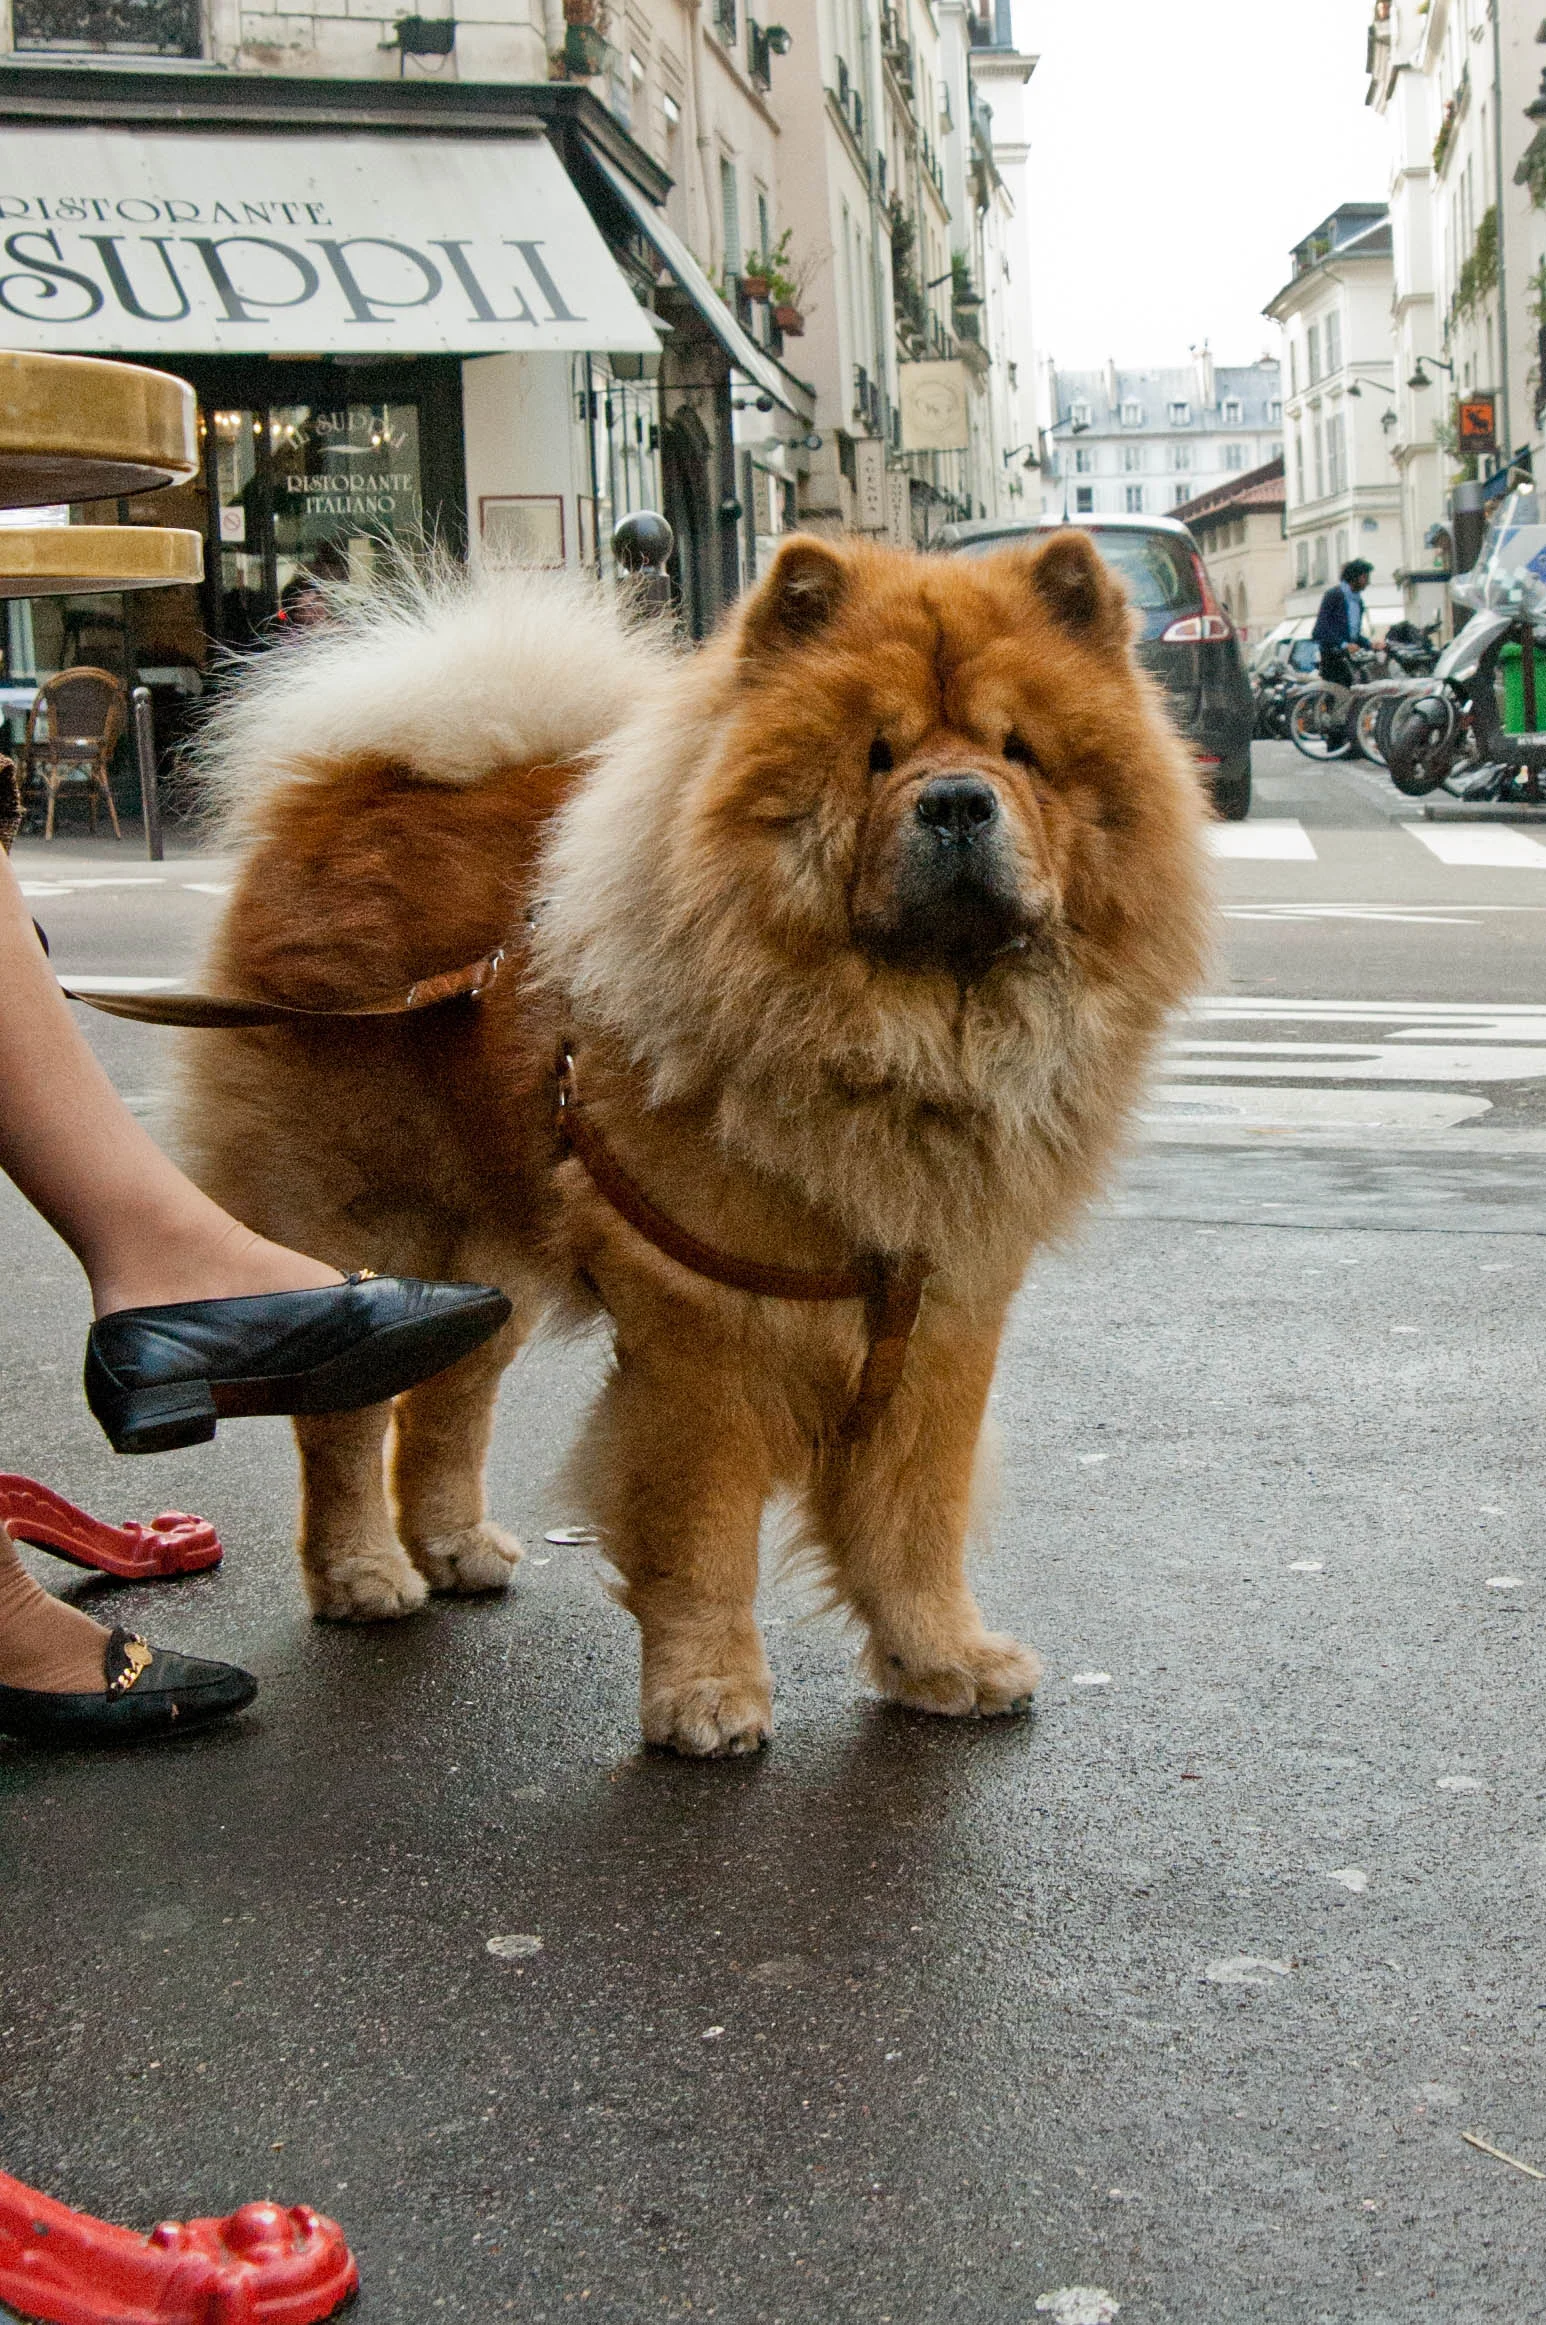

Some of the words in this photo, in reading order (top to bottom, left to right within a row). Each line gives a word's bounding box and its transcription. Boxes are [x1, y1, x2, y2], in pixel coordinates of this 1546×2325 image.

[0, 196, 332, 226] RISTORANTE
[0, 228, 587, 327] SUPPLI
[287, 473, 413, 494] RISTORANTE
[306, 495, 396, 514] ITALIANO
